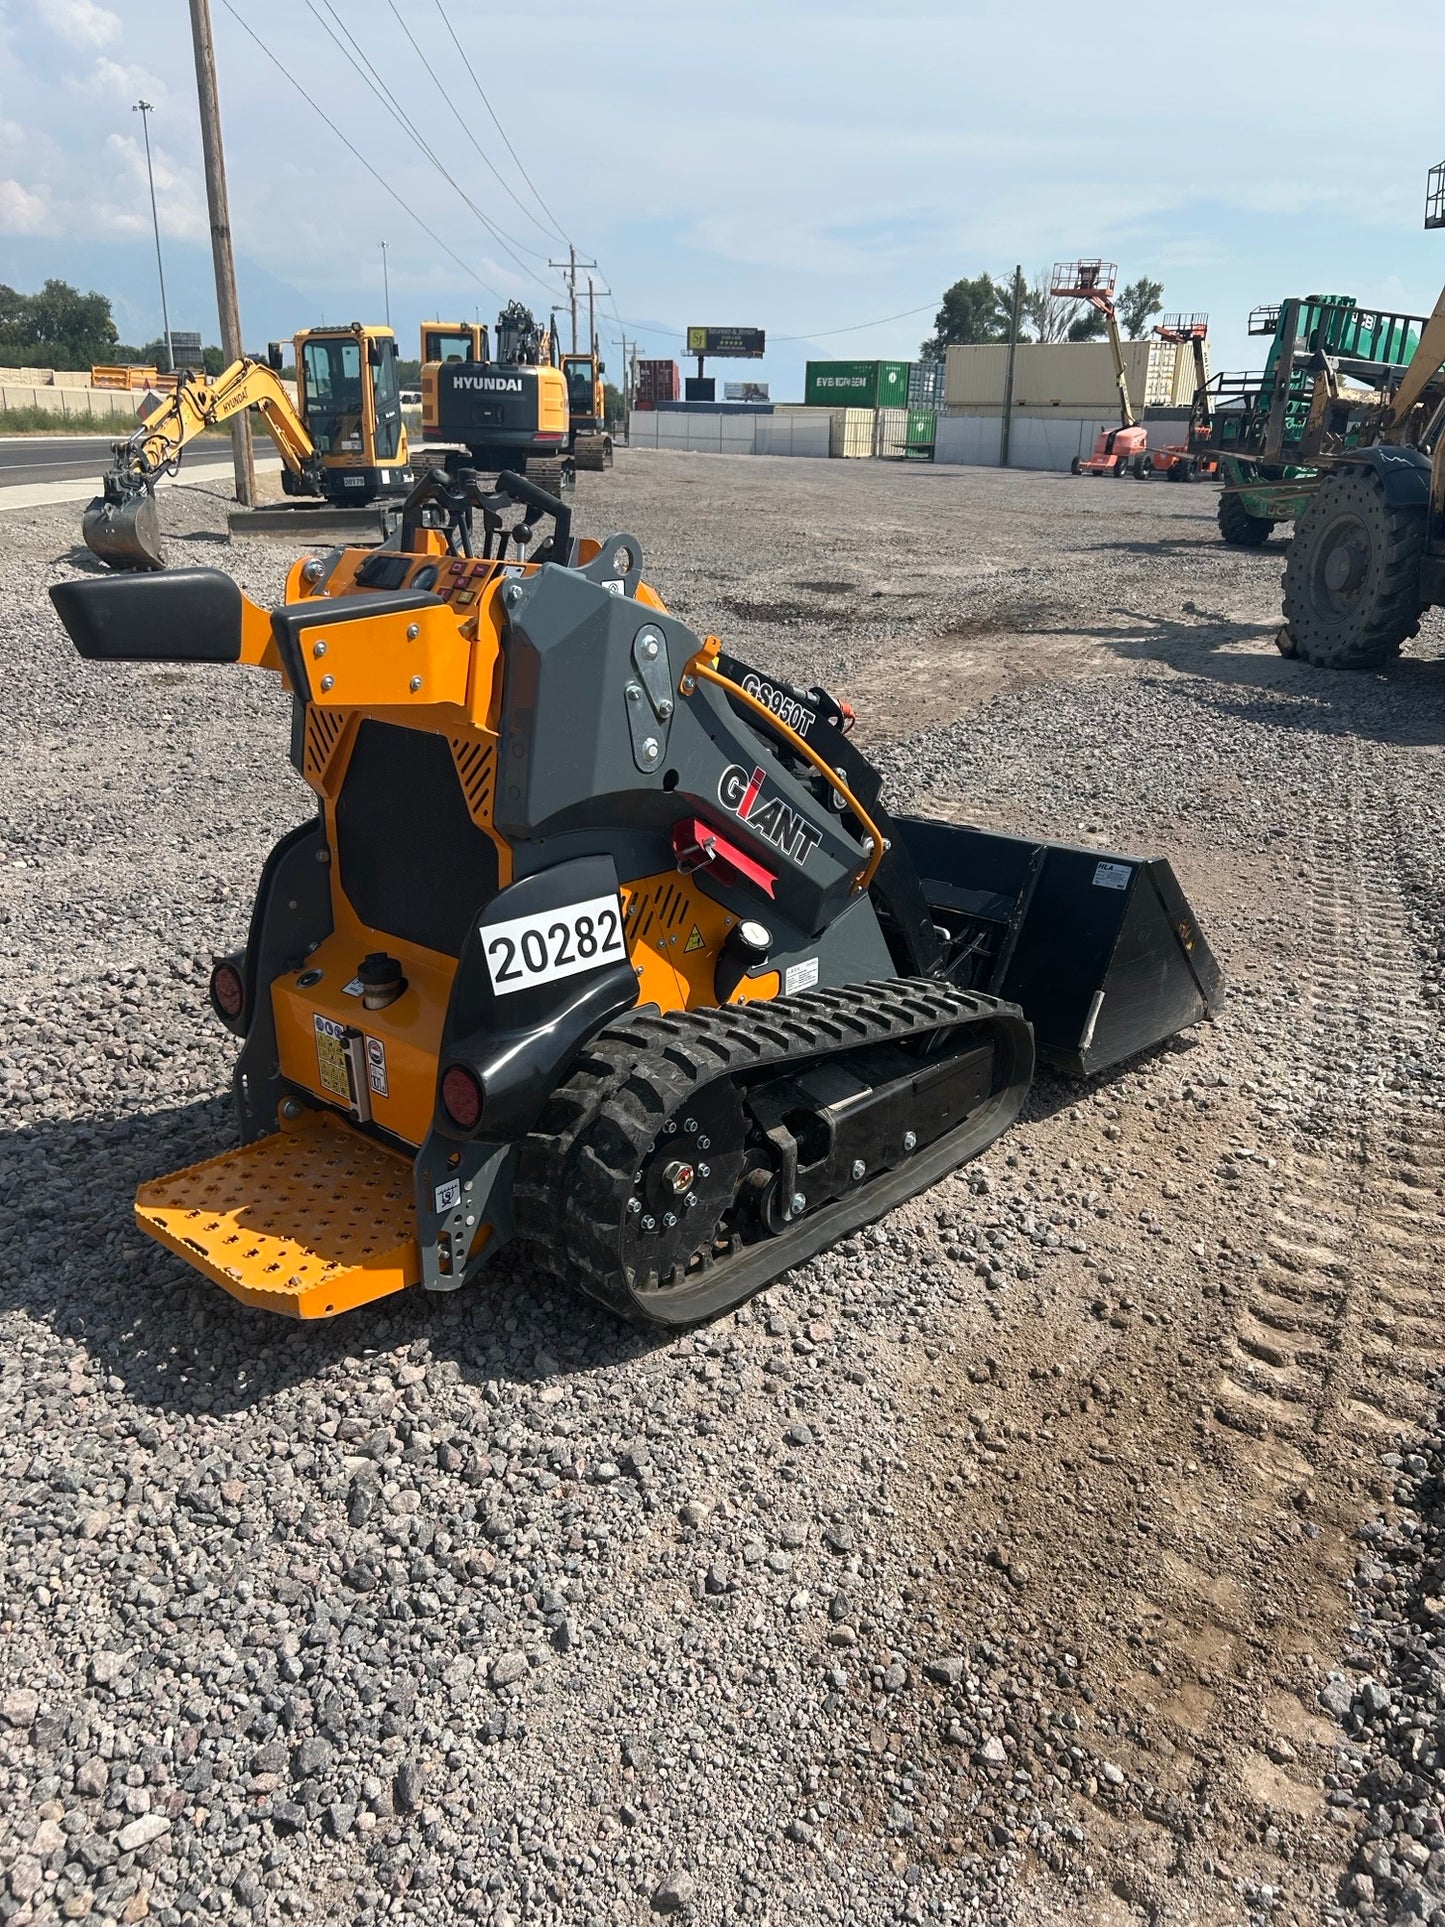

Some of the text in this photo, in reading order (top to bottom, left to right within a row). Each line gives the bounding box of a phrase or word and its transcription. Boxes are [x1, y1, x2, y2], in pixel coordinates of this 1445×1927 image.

[453, 376, 523, 392] HYUNDAI
[816, 377, 867, 388] EVERGREEN
[223, 386, 249, 413] HYUNDAI
[741, 674, 815, 738] GS950T
[1097, 863, 1113, 871] HLA
[488, 909, 622, 984] 20282
